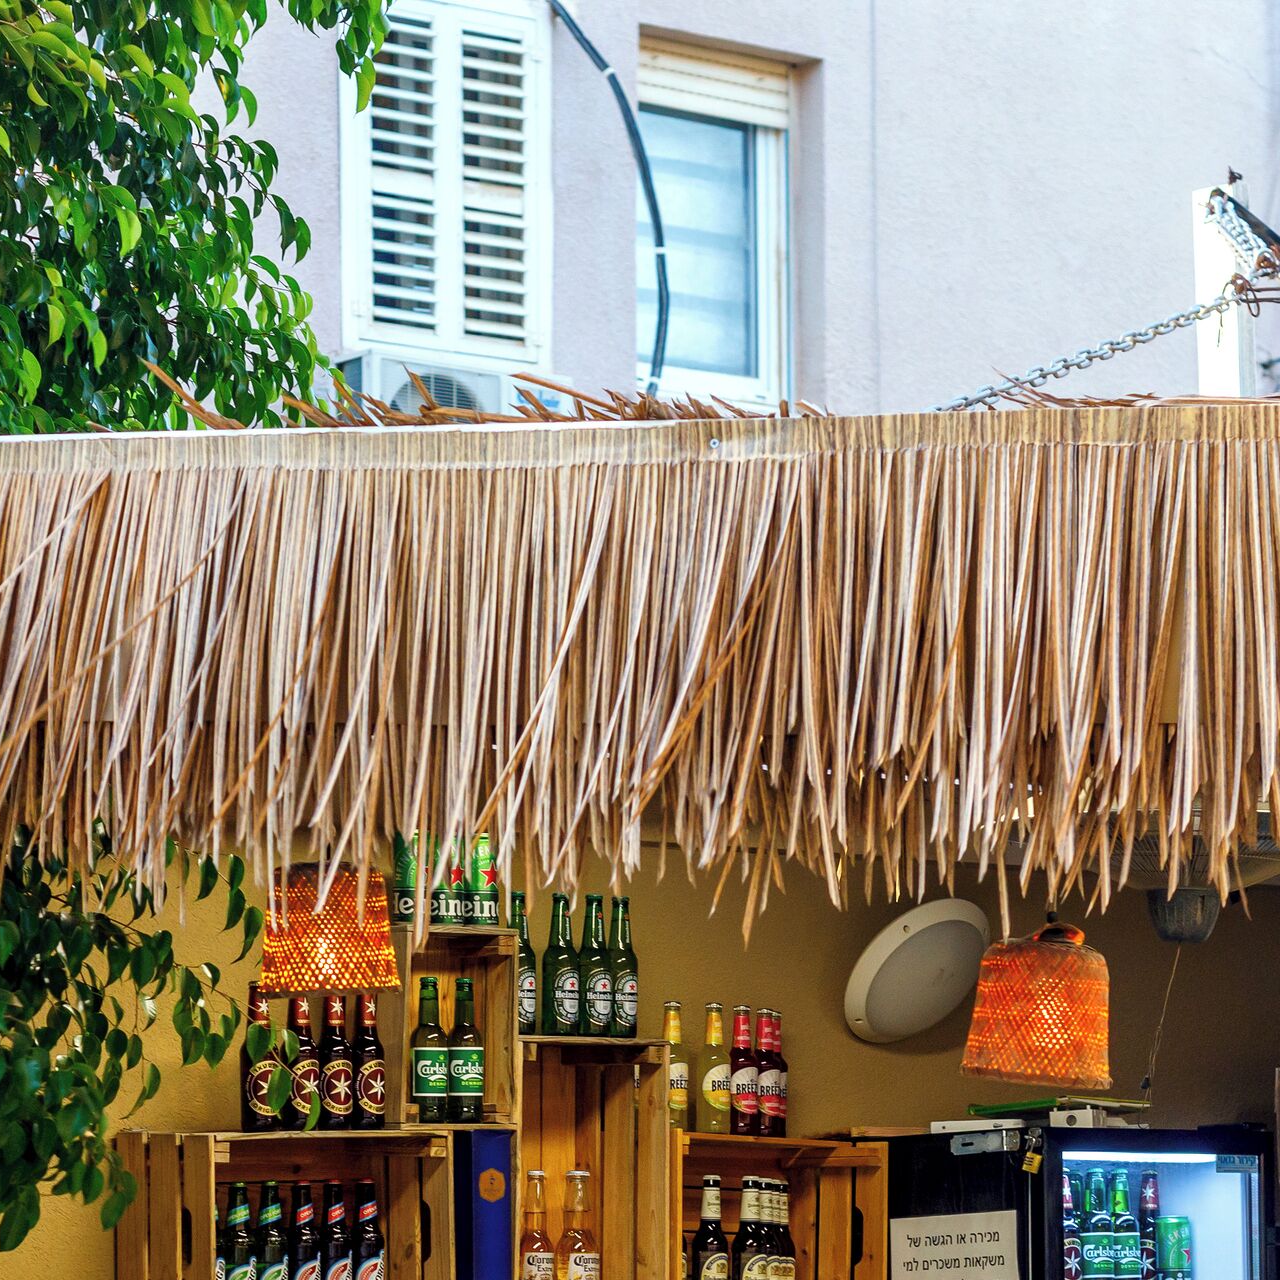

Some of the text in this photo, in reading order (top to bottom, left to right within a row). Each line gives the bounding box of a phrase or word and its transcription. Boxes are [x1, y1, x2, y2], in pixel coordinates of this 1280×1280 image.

[907, 1231, 1000, 1248] מכירה או הגשה של
[903, 1254, 1005, 1272] משקאות משכרים למי
